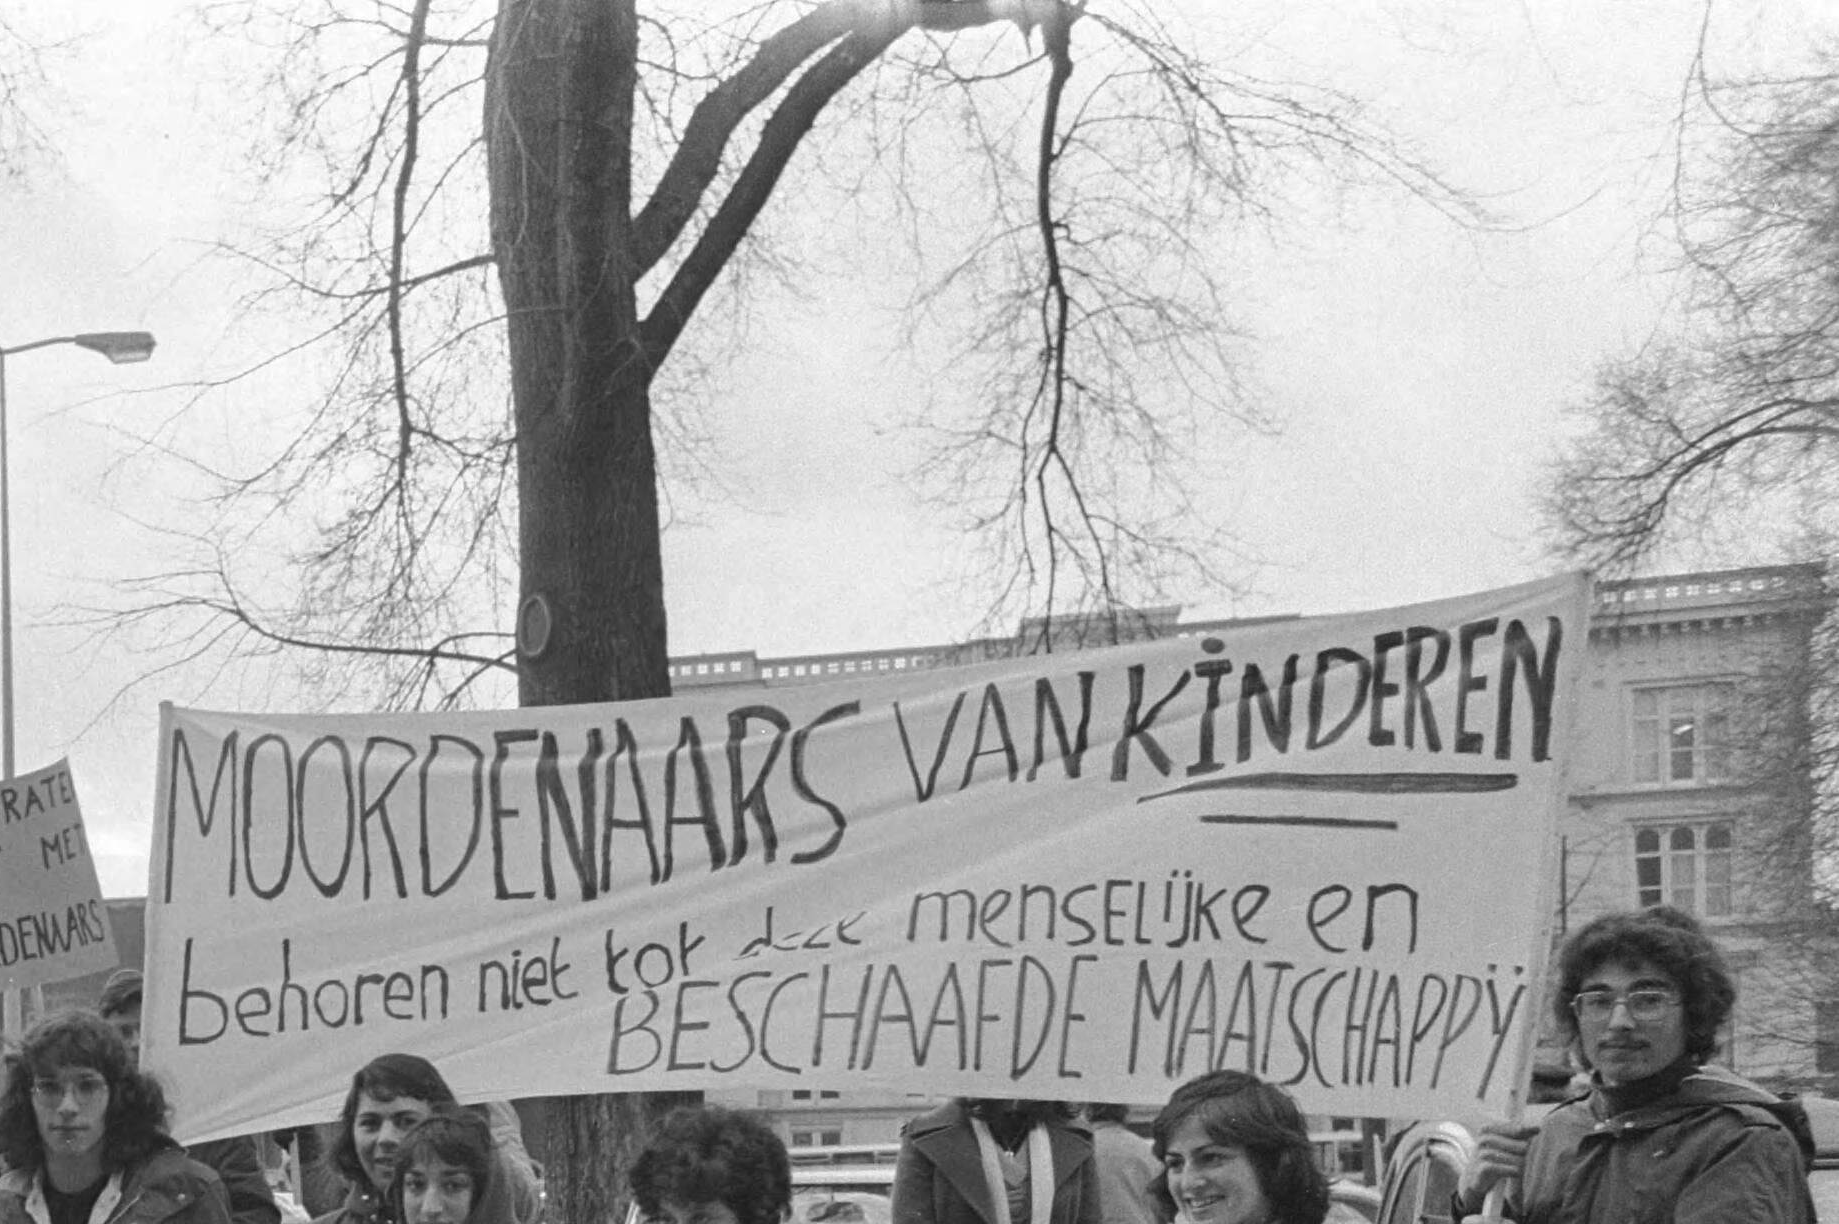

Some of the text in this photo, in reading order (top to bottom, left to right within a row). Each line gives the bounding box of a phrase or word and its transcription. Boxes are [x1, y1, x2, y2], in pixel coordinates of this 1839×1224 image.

[164, 702, 861, 904] MOORDENAARS
[892, 672, 1095, 803] VAN
[178, 937, 449, 1046] behoren
[478, 936, 579, 1014] niet
[605, 921, 706, 995] tot
[1307, 882, 1419, 955] en
[607, 955, 1098, 1080] BESCHAAFDE
